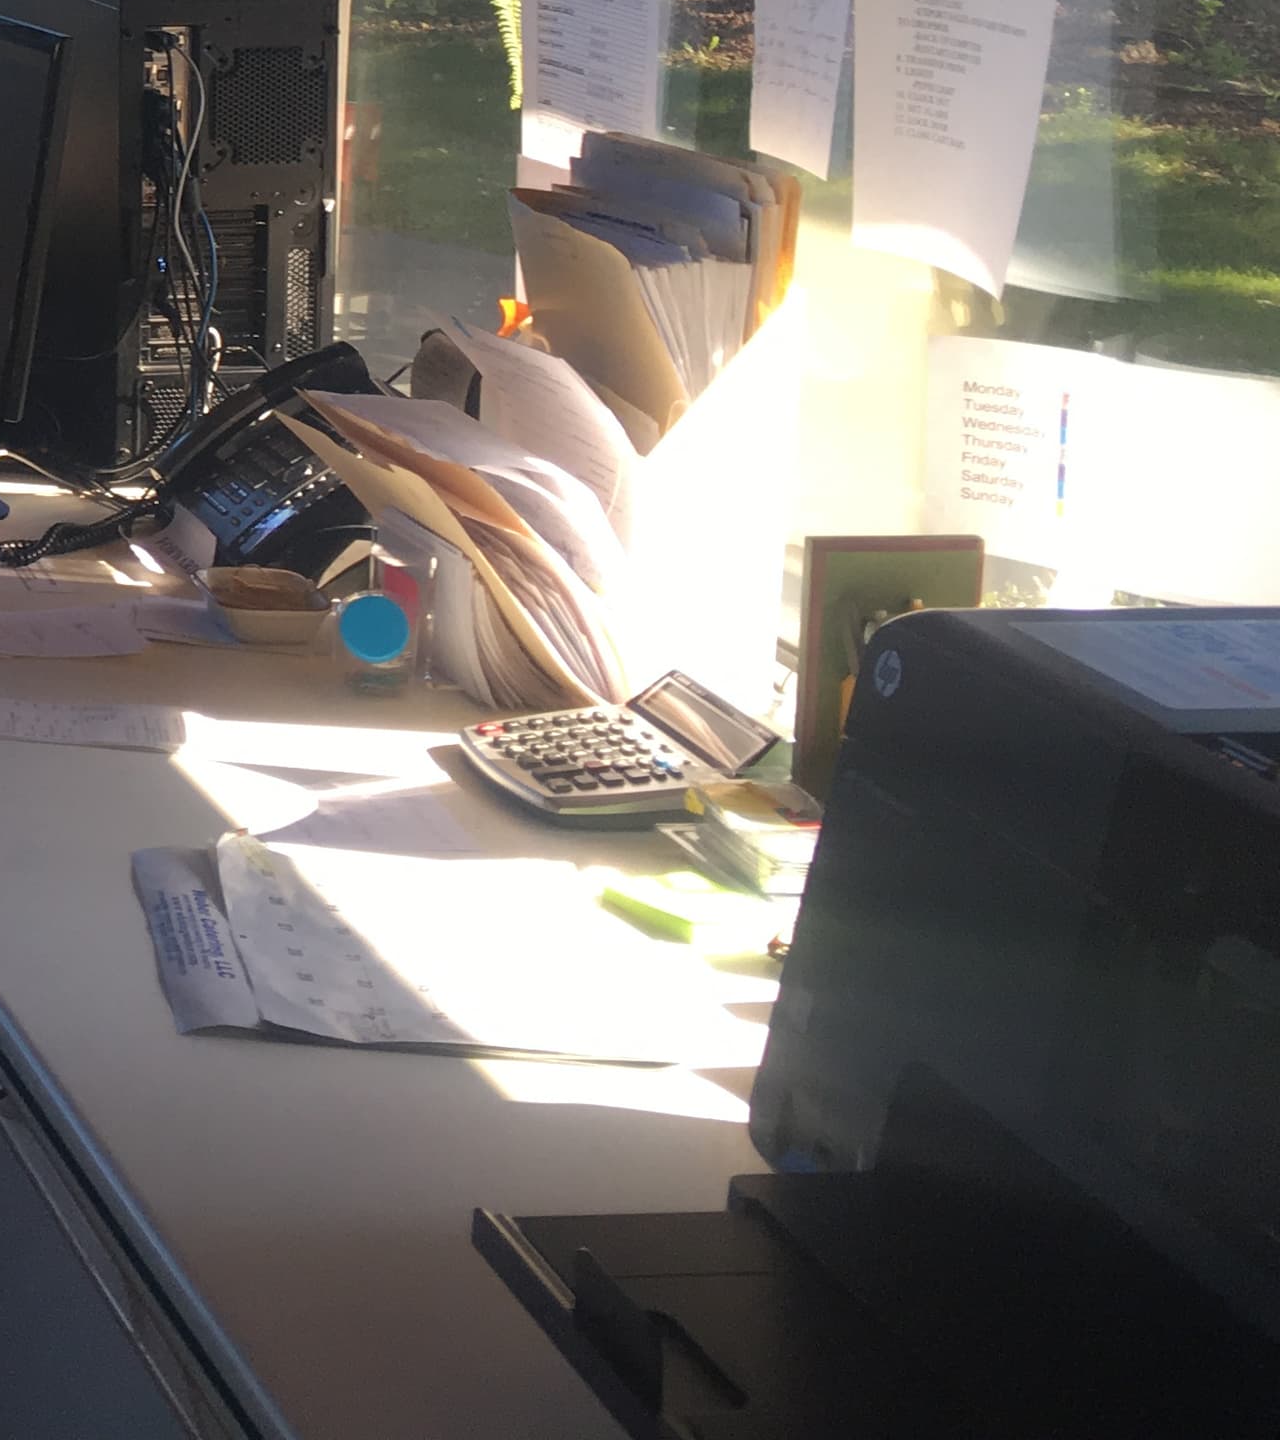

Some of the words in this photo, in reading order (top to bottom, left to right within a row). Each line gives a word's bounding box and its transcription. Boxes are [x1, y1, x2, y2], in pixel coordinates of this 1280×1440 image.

[962, 380, 1023, 400] Monday
[963, 397, 1025, 418] Tuesday
[962, 416, 1046, 439] Wednesday
[961, 433, 1029, 455] Thursday
[960, 451, 1007, 469] Friday
[960, 469, 1024, 491] Saturday
[959, 486, 1016, 509] Sunday
